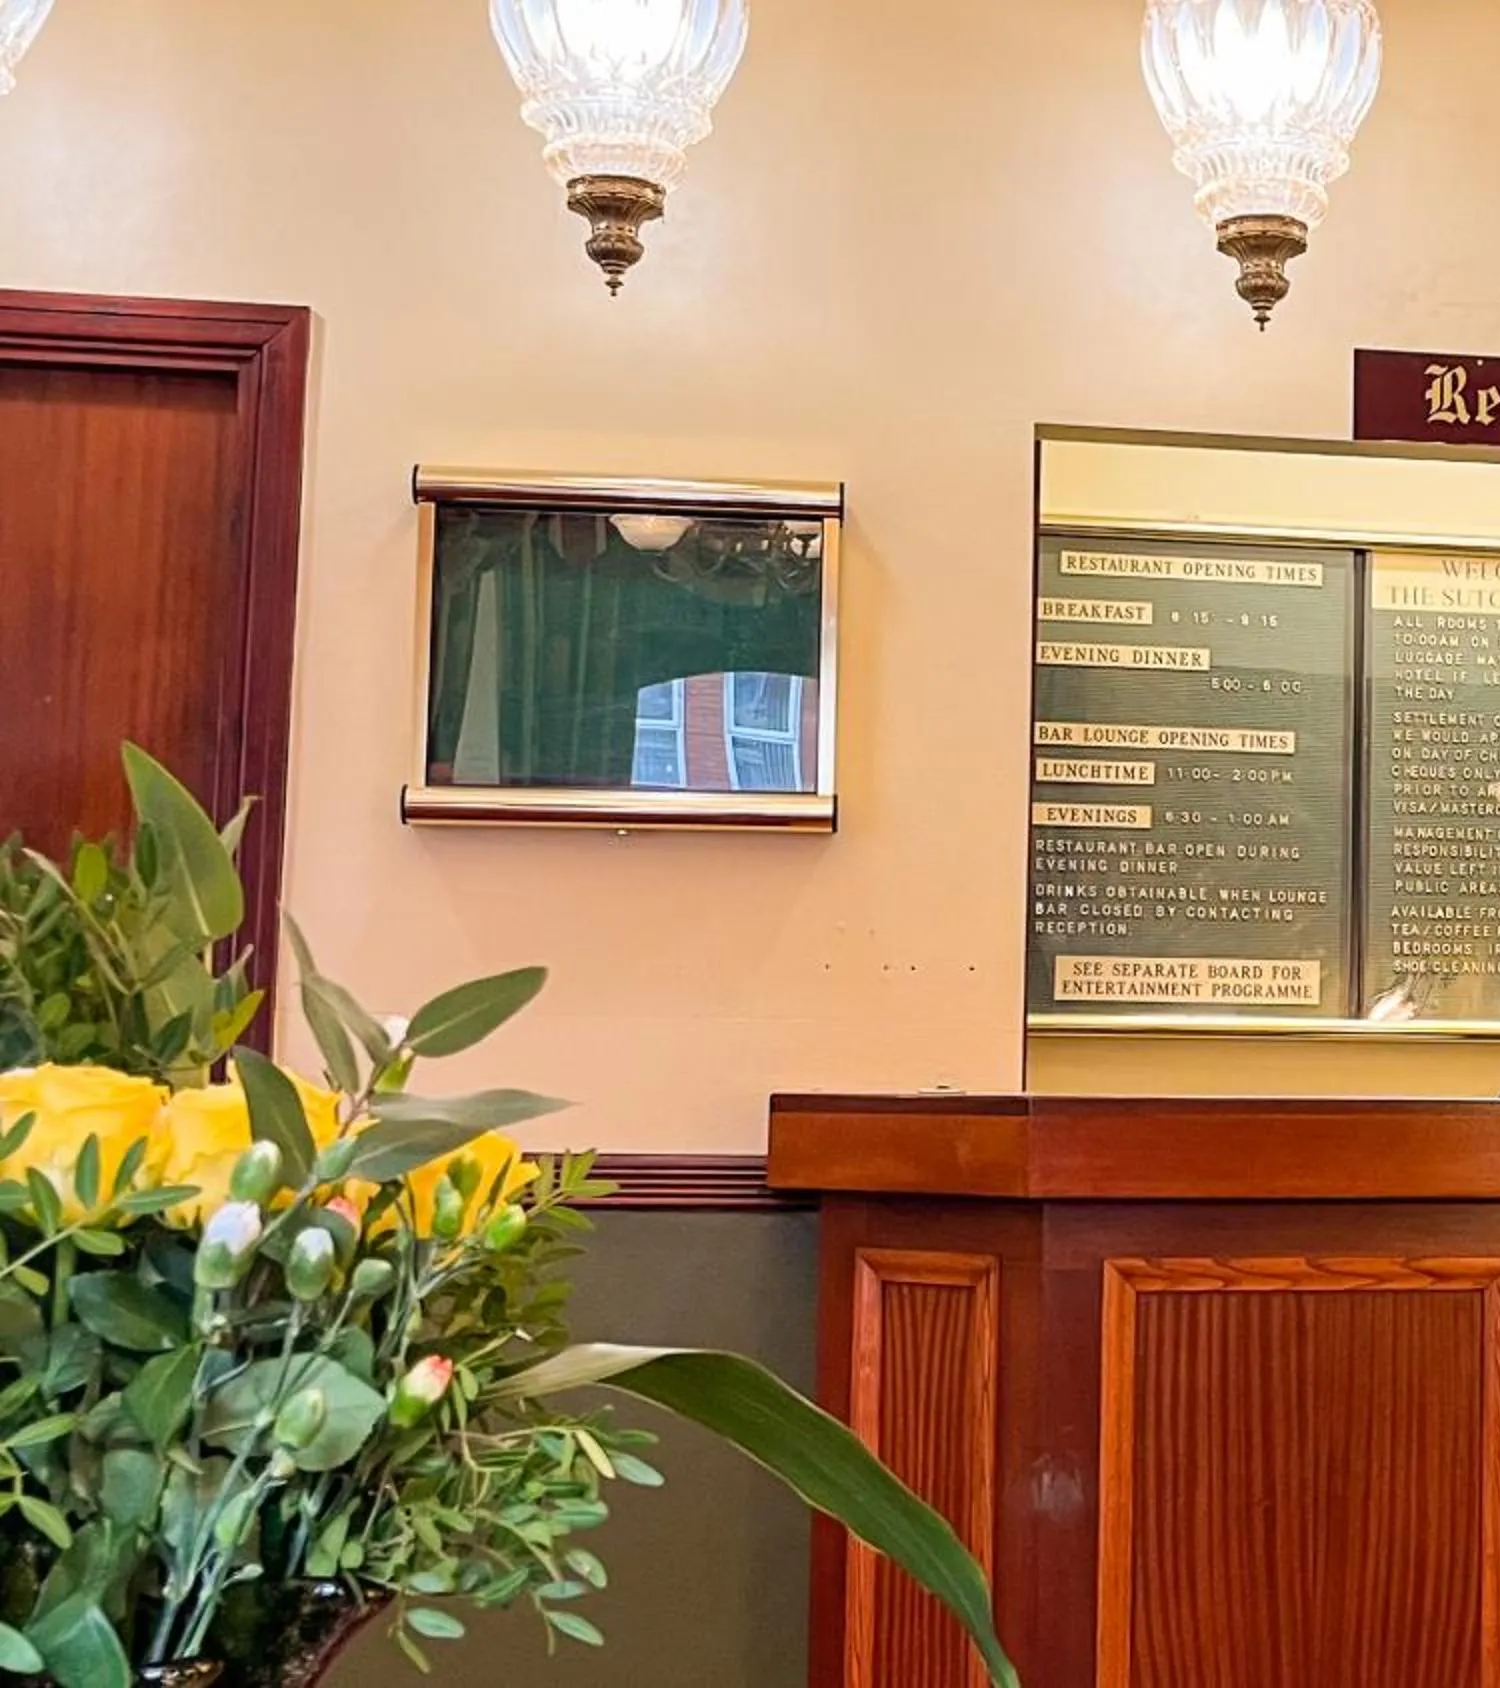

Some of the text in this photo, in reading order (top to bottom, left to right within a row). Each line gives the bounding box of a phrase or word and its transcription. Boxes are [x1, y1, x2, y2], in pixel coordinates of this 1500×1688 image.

[1066, 556, 1317, 582] RESTAURANT OPENING TIMES
[1386, 585, 1434, 606] THE
[1042, 602, 1146, 621] BREAKFAST
[1393, 615, 1423, 628] ALL
[1436, 616, 1487, 631] ROOMS
[1471, 635, 1489, 648] ON
[1040, 645, 1204, 667] EVENING DINNER
[1395, 651, 1464, 665] LUGGAGE
[1394, 668, 1445, 682] HOTEL
[1453, 671, 1468, 683] IF
[1395, 685, 1455, 701] THE DAY
[1393, 712, 1485, 727] SETTLEMENT
[1038, 725, 1288, 749] BAR LOUNGE OPENING TIMES
[1393, 729, 1414, 742] WE
[1421, 730, 1469, 744] WOULD
[1392, 747, 1412, 760] ON
[1422, 748, 1449, 761] DAY
[1455, 749, 1473, 762] OF
[1043, 762, 1150, 780] LUNCHTIME
[1391, 764, 1457, 779] CHEQUES
[1463, 766, 1500, 780] ONLY
[1393, 782, 1470, 798] PRIOR TO
[1047, 807, 1137, 823] EVENINGS
[1392, 826, 1493, 841] MANAGEMENT
[1035, 839, 1300, 859] RESTAURANT BAR OPEN DURING
[1035, 857, 1178, 874] EVENING DINNER
[1395, 862, 1444, 876] VALUE
[1449, 863, 1486, 877] LEFT
[1035, 883, 1098, 898] DRINKS
[1219, 888, 1261, 902] WHEN
[1269, 889, 1328, 903] LOUNGE
[1395, 879, 1449, 894] PUBLIC
[1035, 903, 1294, 921] BAR CLOSED BY CONTACTING
[1391, 905, 1472, 919] AVAILABLE
[1391, 923, 1493, 937] TEA/COFFEE
[1392, 941, 1474, 956] BEDROOMS
[1073, 961, 1302, 980] SEE SEPARATE BOARD FOR
[1392, 960, 1428, 973] SHOE
[1062, 980, 1313, 999] ENTERTAINMENT PROGRAMME
